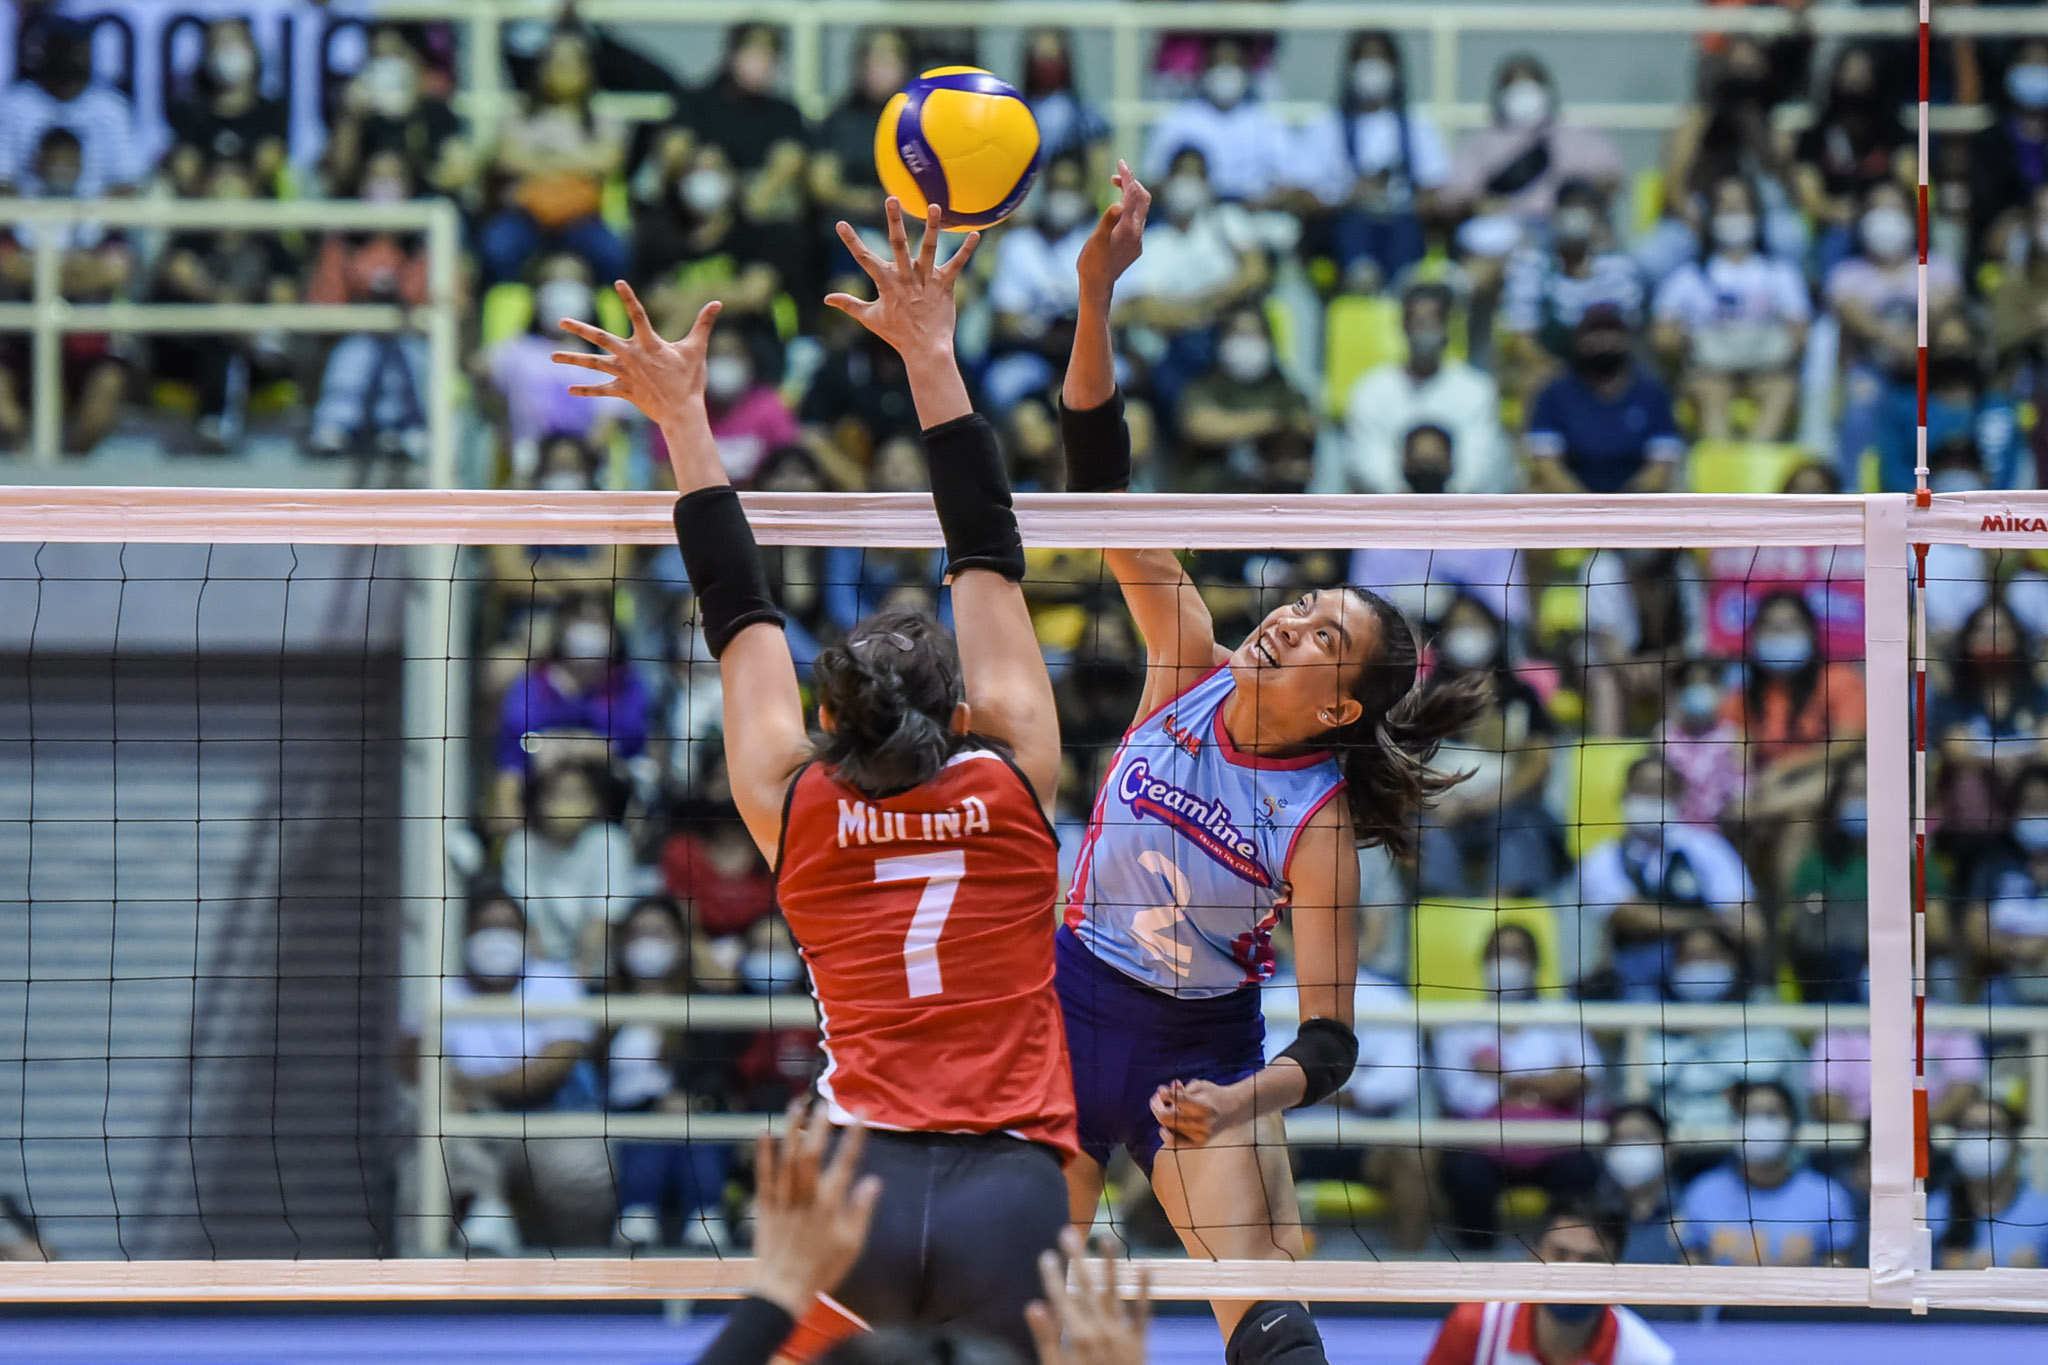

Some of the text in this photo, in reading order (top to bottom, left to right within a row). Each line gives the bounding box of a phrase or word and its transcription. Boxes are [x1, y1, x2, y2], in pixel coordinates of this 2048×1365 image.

[1120, 761, 1255, 860] Creamline
[873, 850, 966, 998] 7
[1128, 850, 1192, 978] 2
